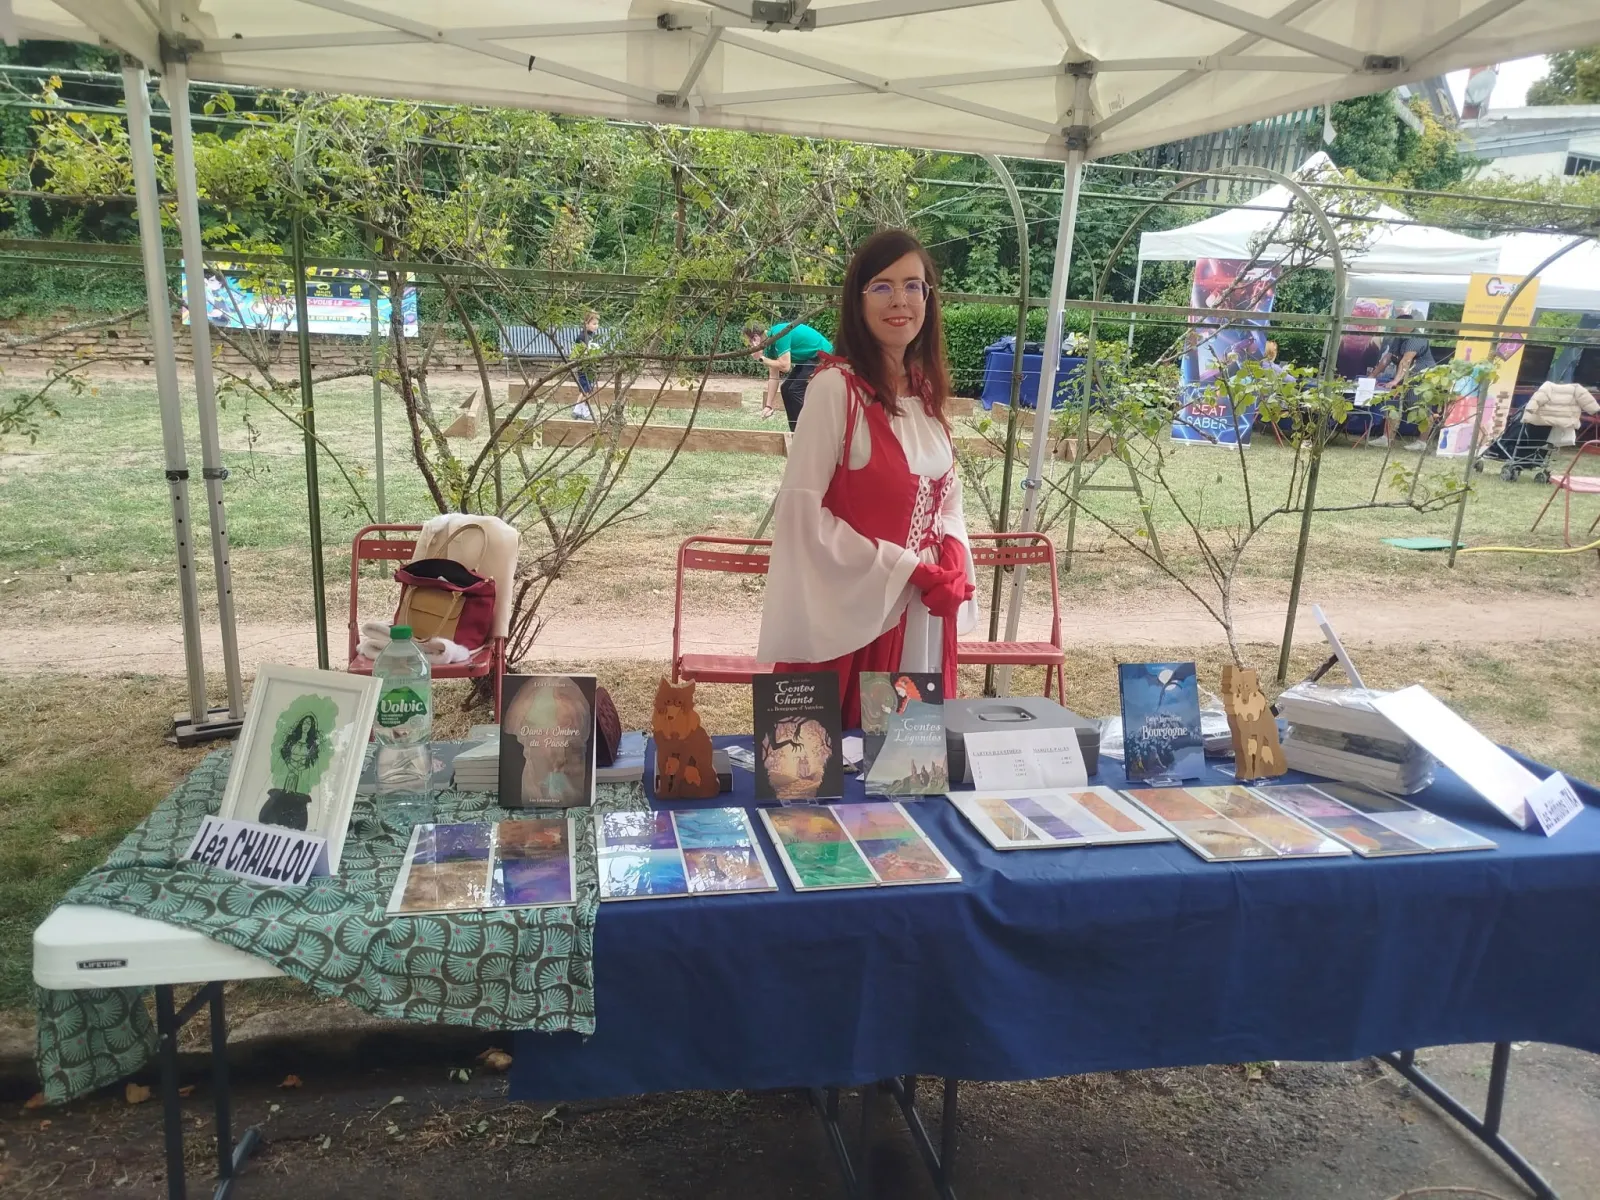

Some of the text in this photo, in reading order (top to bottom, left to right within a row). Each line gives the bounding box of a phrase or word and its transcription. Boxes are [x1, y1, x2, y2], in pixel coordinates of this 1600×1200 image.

[1192, 403, 1227, 416] BEAT
[1186, 415, 1228, 430] SABER
[775, 680, 815, 693] Contes
[774, 692, 814, 705] Chants
[380, 699, 424, 714] Volvic
[520, 725, 543, 737] Dans
[901, 718, 942, 731] Contes
[1142, 725, 1188, 741] Bourgogne
[529, 739, 540, 747] du
[190, 821, 319, 884] Léa CHAILLOU
[83, 960, 122, 968] LIFETIME
